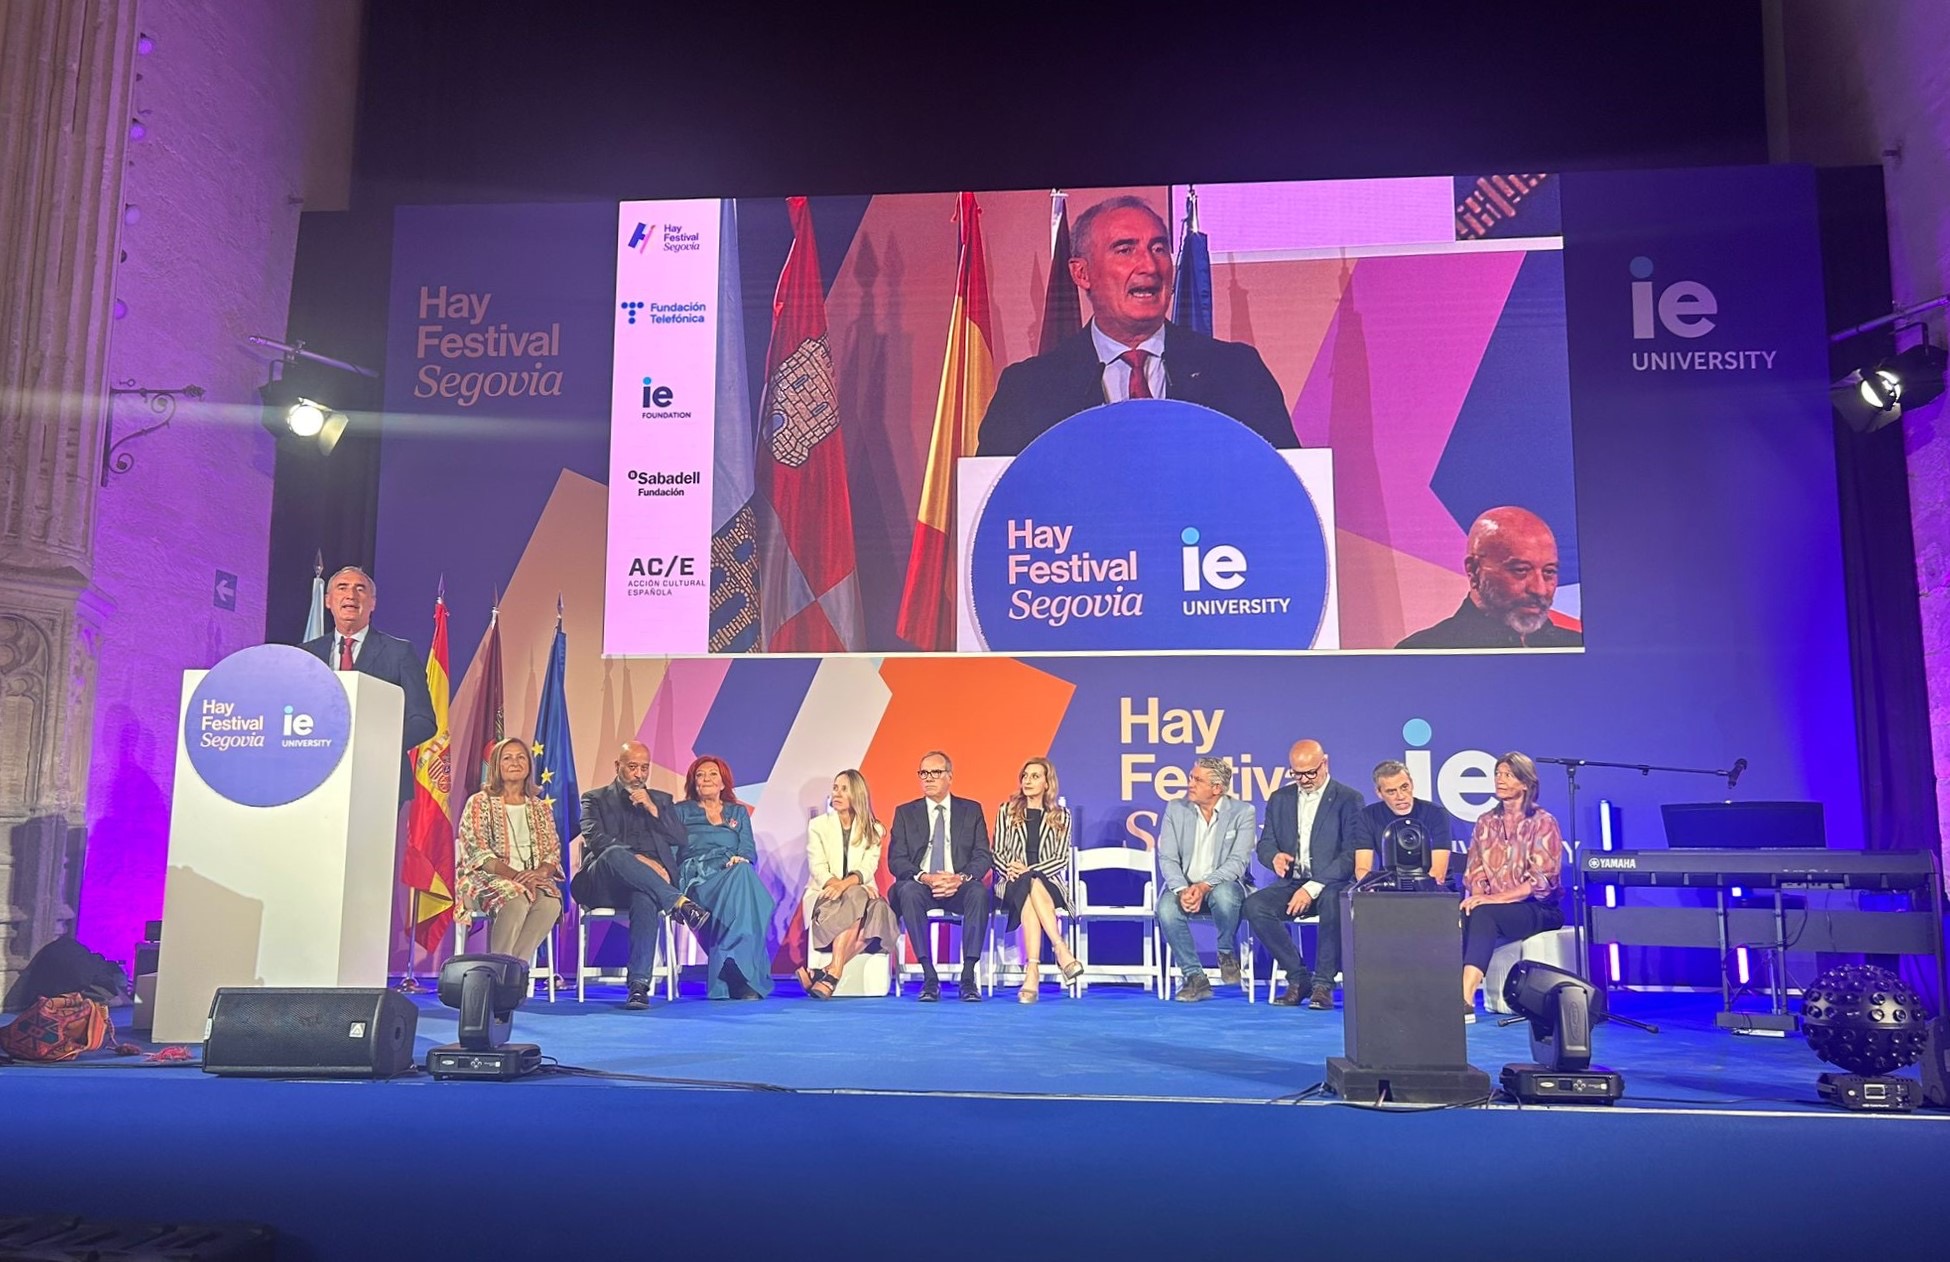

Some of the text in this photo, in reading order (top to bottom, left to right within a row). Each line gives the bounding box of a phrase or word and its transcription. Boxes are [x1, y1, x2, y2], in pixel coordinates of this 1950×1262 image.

[663, 233, 699, 242] Festival
[664, 224, 682, 233] Hay
[419, 286, 492, 325] Hay
[650, 302, 706, 312] Fundación
[1630, 256, 1717, 339] ie
[650, 313, 705, 324] Telefónica
[417, 323, 560, 359] Festival
[1632, 351, 1777, 371] UNIVERSITY
[414, 362, 563, 406] Segovia
[642, 377, 674, 408] ie
[637, 471, 701, 485] Sabadell
[638, 488, 685, 496] Fundación
[1008, 519, 1073, 554] Hay
[628, 555, 695, 577] AC/E
[1008, 551, 1138, 584] Festival
[1180, 526, 1247, 592] ie
[627, 579, 706, 587] ACCIÓN CULTURAL
[627, 588, 673, 596] ESPAÑOLA
[1008, 586, 1144, 627] Segovia
[1183, 598, 1291, 616] UNIVERSITY
[202, 699, 235, 717] Hay
[201, 715, 264, 731] Festival
[283, 705, 314, 736] ie
[1120, 697, 1225, 753] Hay
[200, 732, 265, 751] Segovia
[282, 739, 332, 748] UNIVERSITY
[1402, 718, 1501, 823] ie
[1600, 858, 1636, 868] YAMAHA
